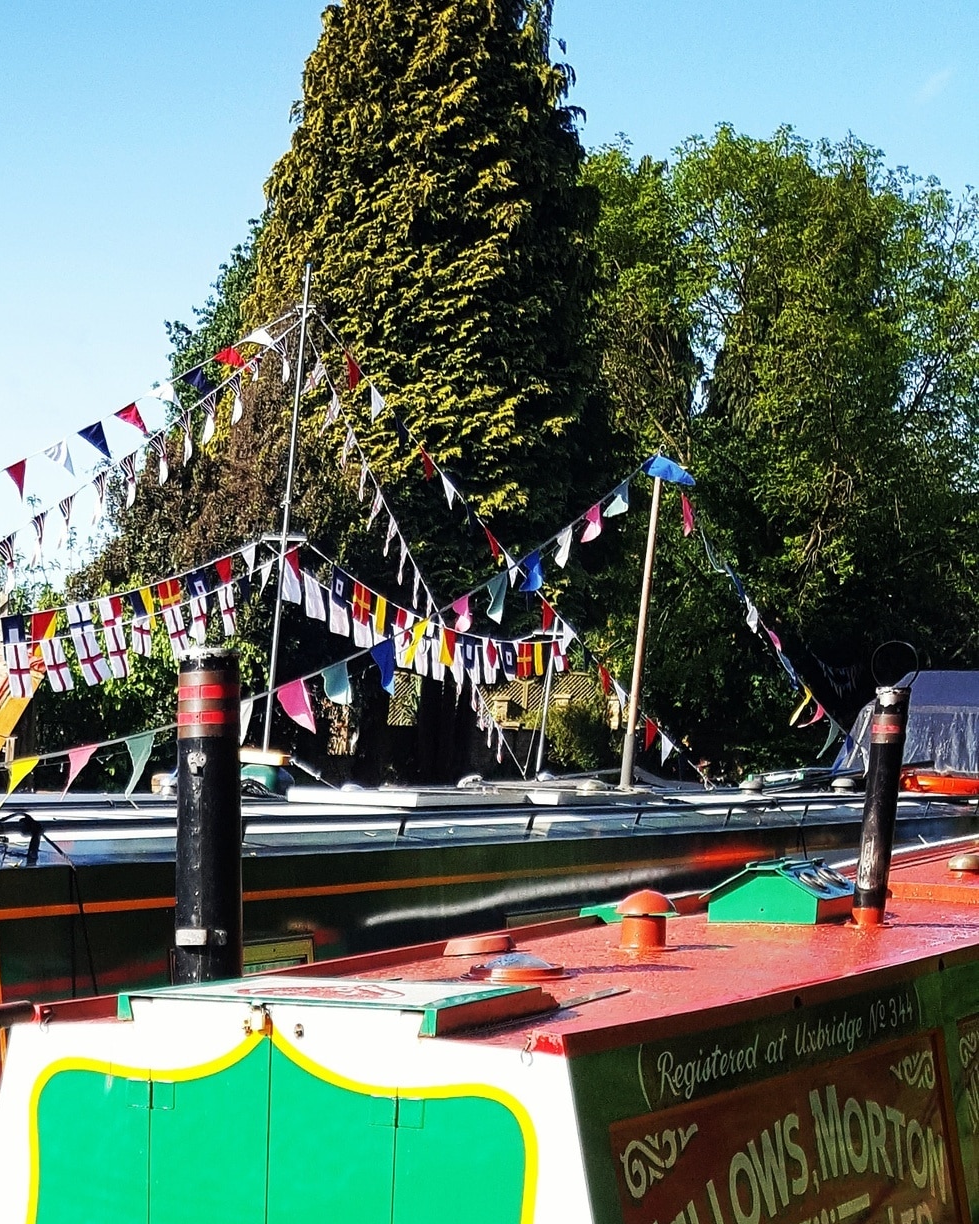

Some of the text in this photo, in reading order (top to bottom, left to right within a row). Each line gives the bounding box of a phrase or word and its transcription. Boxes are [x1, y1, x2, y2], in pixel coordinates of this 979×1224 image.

[765, 1028, 788, 1064] at
[795, 1011, 862, 1056] Uxbridge
[888, 992, 913, 1028] 344
[809, 1084, 947, 1205] MORTON
